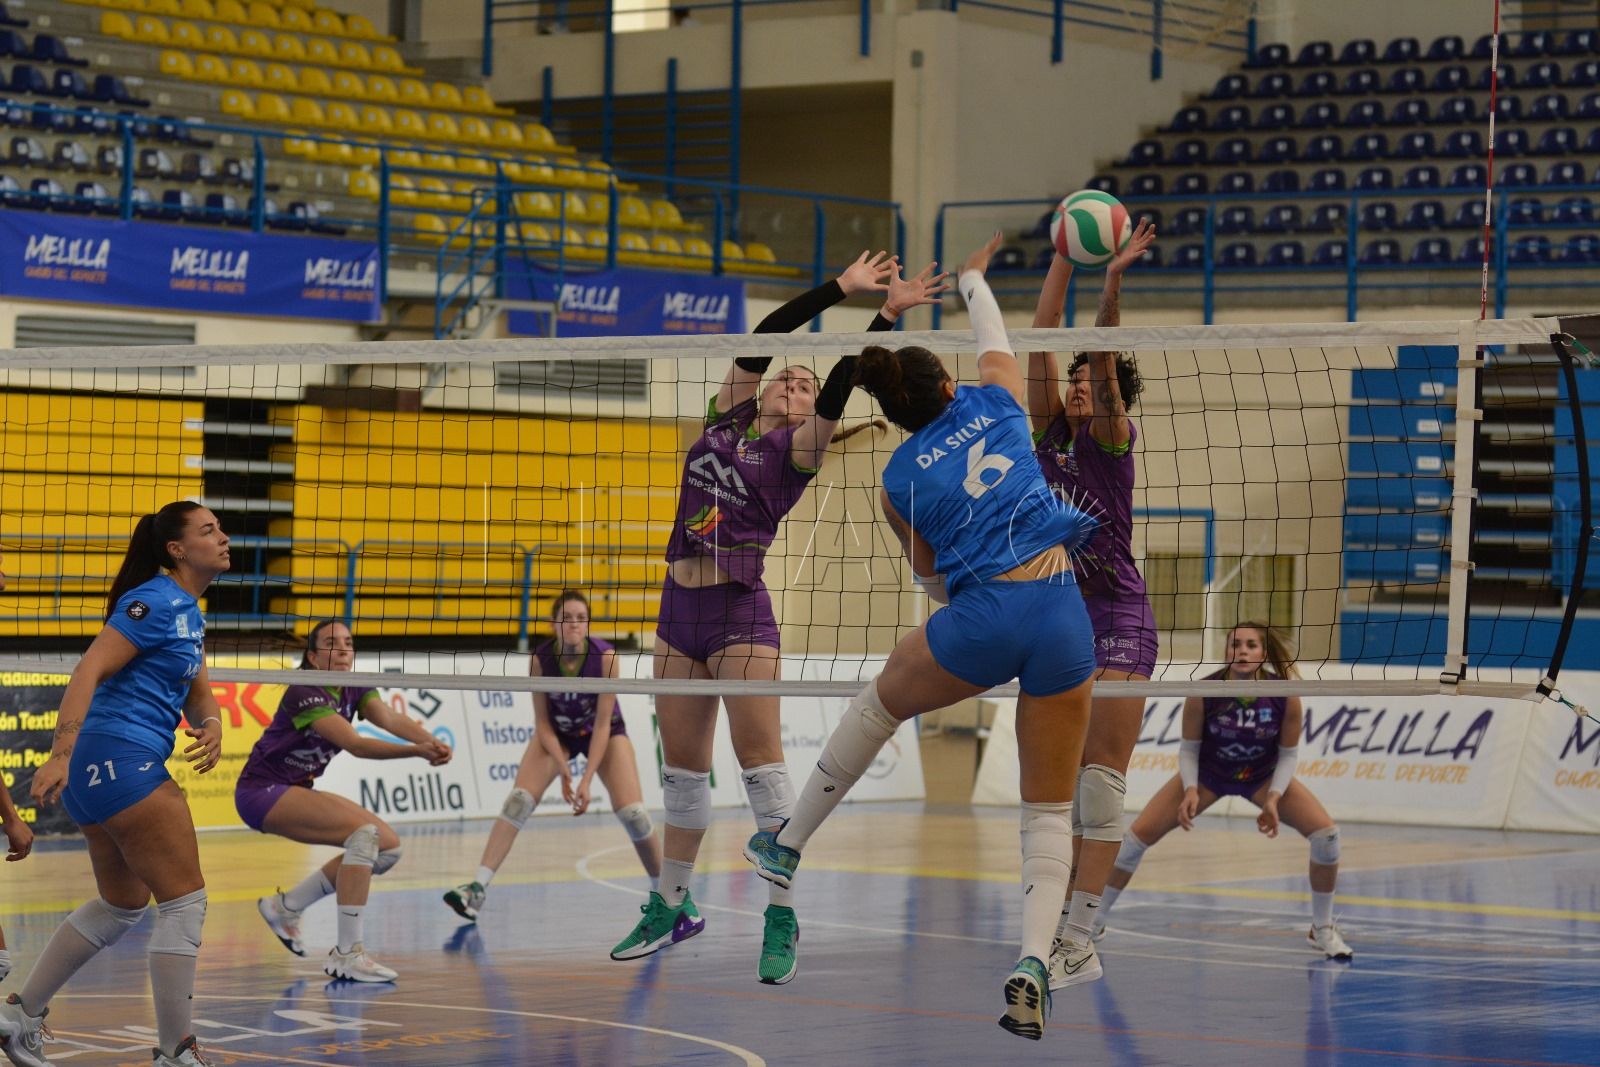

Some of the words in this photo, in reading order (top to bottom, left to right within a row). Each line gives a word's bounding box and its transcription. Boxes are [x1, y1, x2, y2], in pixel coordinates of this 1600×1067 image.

[24, 234, 111, 269] MELILLA
[170, 246, 249, 279] MELILLA
[304, 258, 376, 289] MELILLA
[663, 291, 730, 321] MELILLA
[915, 447, 948, 470] DA
[945, 414, 997, 450] SILVA
[962, 436, 1015, 499] 6
[482, 721, 534, 744] histor
[1236, 708, 1256, 728] 12
[1302, 704, 1494, 761] MELILLA
[85, 760, 117, 788] 21
[1355, 762, 1386, 781] DEL
[1395, 764, 1472, 785] DEPORTE
[360, 773, 465, 814] Melilla
